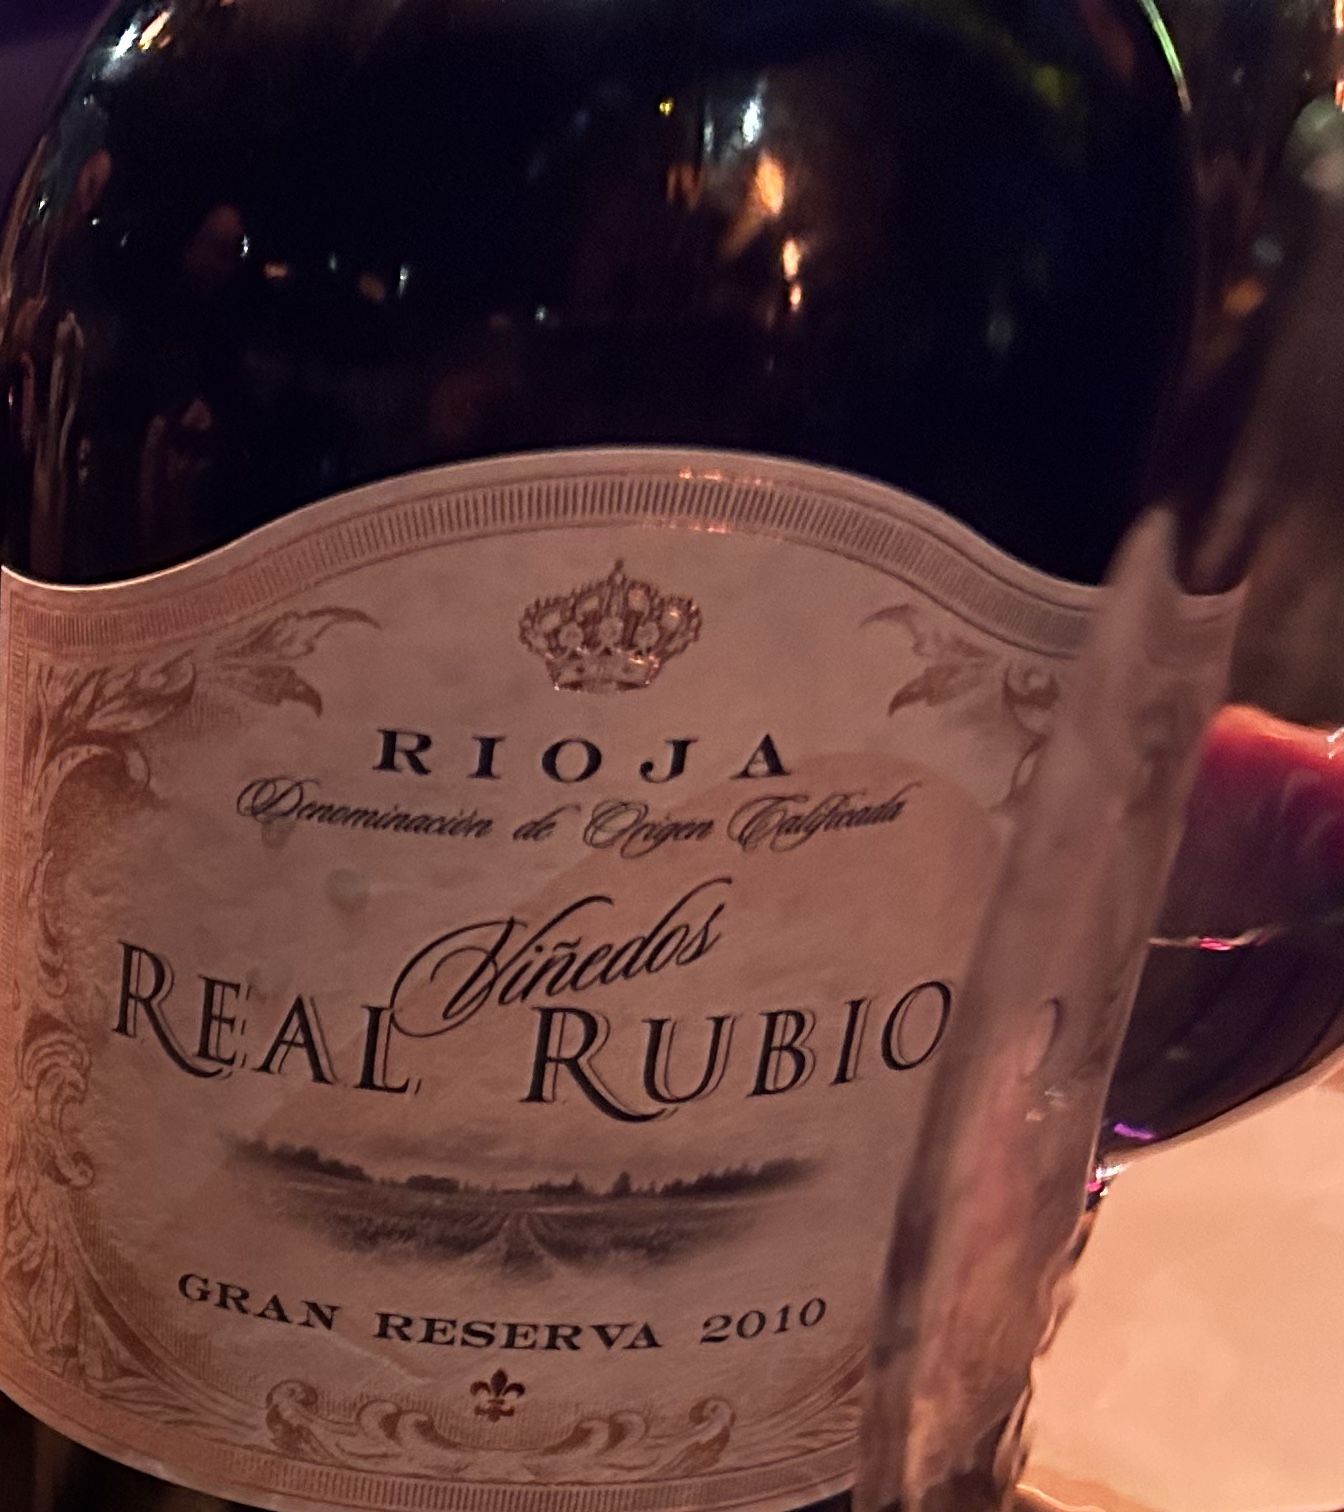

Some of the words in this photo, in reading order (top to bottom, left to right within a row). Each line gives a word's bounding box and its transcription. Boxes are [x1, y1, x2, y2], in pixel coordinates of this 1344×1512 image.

[372, 727, 791, 784] RIOJA
[236, 776, 495, 840] Denominación
[511, 803, 581, 842] de
[583, 800, 715, 859] Origen
[389, 876, 733, 1038] Viñedos
[113, 939, 422, 1095] REAL
[519, 978, 954, 1124] RUBIO
[177, 1272, 341, 1331] GRAN
[373, 1311, 663, 1352] RESERVA
[700, 1296, 827, 1345] 2010
